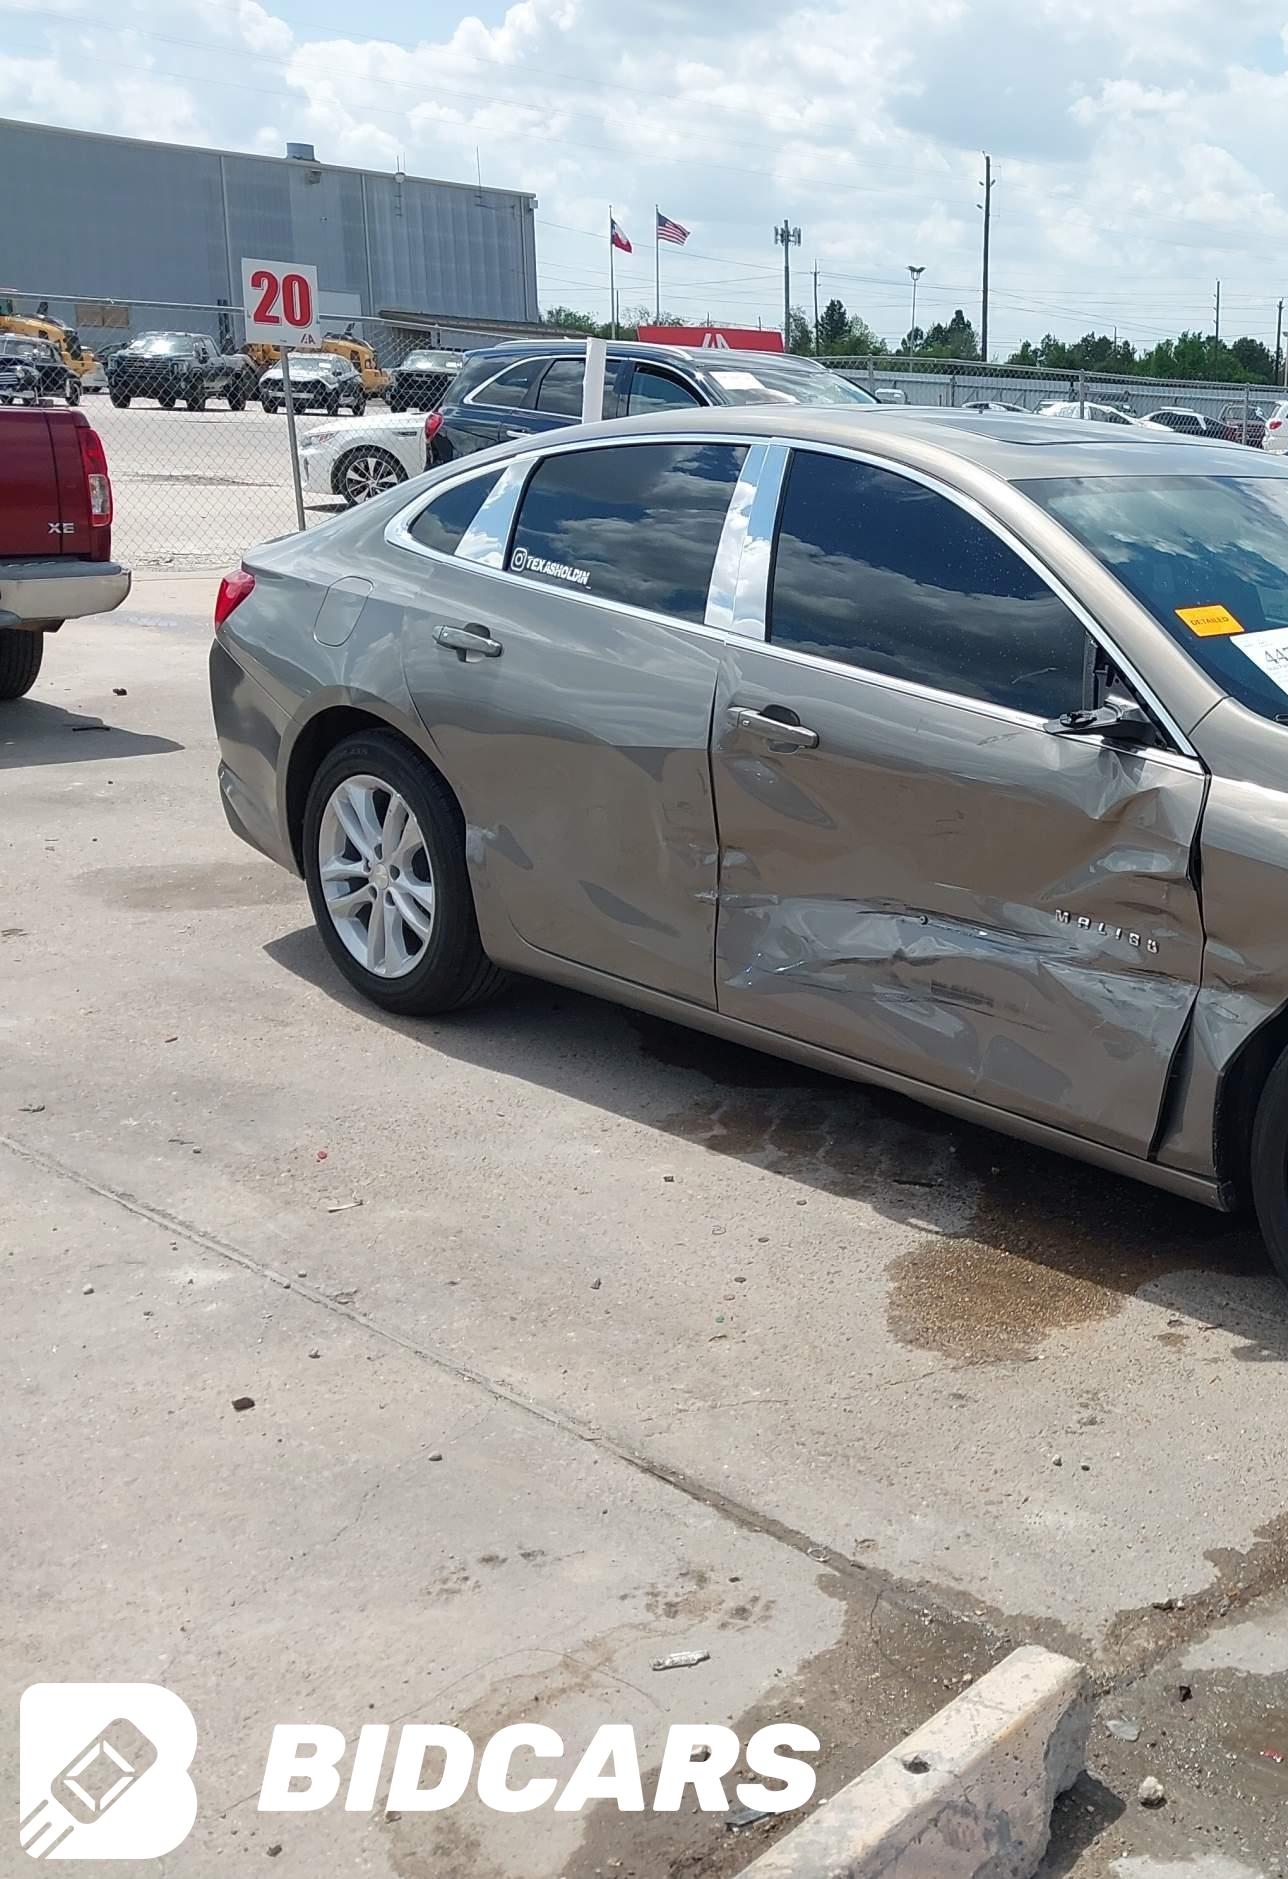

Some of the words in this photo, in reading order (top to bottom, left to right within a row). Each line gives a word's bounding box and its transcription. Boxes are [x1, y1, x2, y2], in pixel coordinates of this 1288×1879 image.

[250, 269, 313, 329] 20
[47, 522, 75, 534] XE
[1055, 908, 1158, 954] MALIBU
